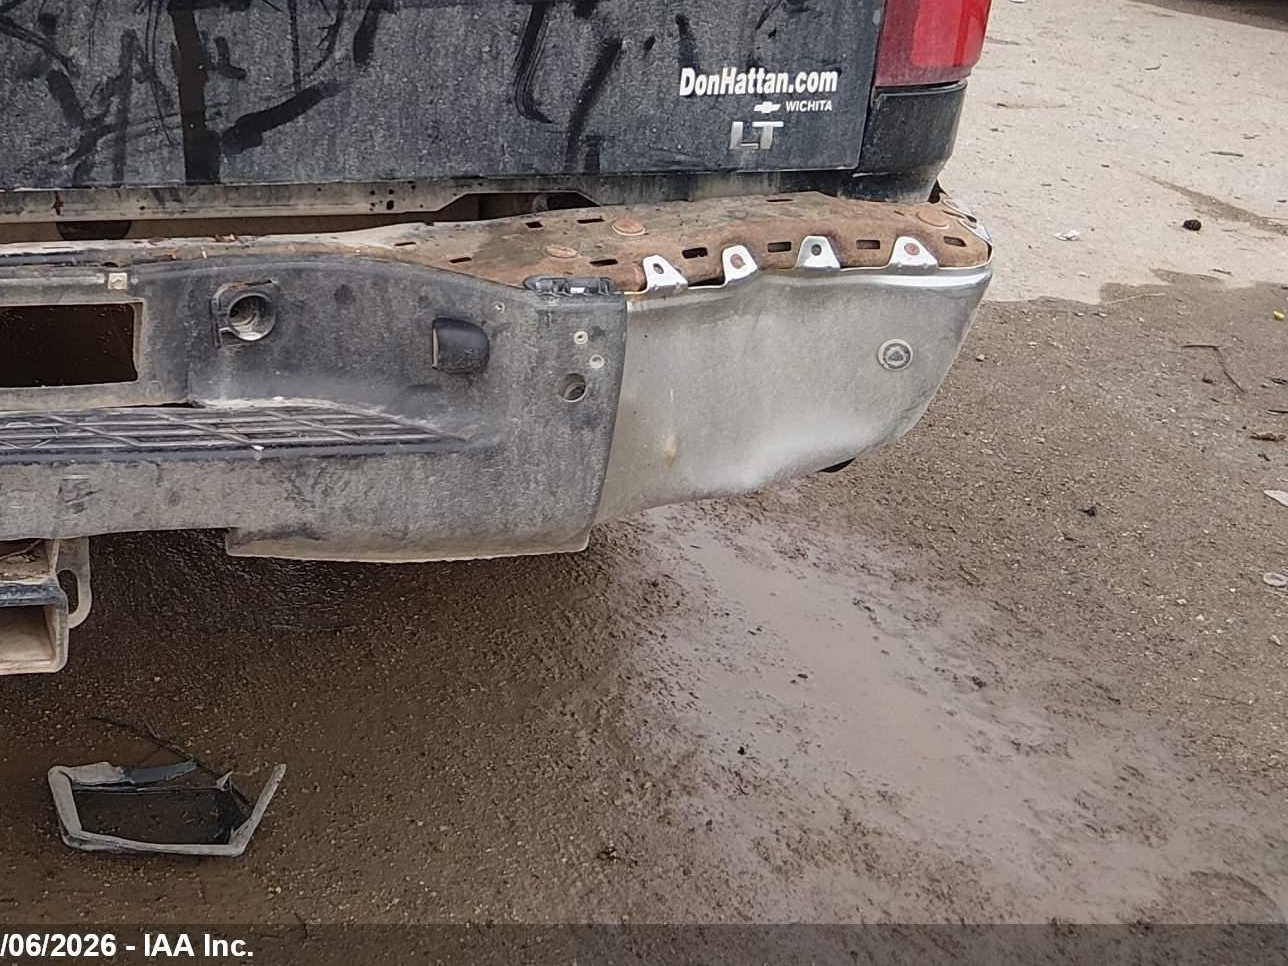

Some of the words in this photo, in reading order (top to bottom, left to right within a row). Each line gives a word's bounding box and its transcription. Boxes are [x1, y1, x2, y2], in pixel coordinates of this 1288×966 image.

[679, 67, 838, 96] DonHattan.com
[786, 100, 833, 112] WICHITA
[729, 121, 784, 150] LT
